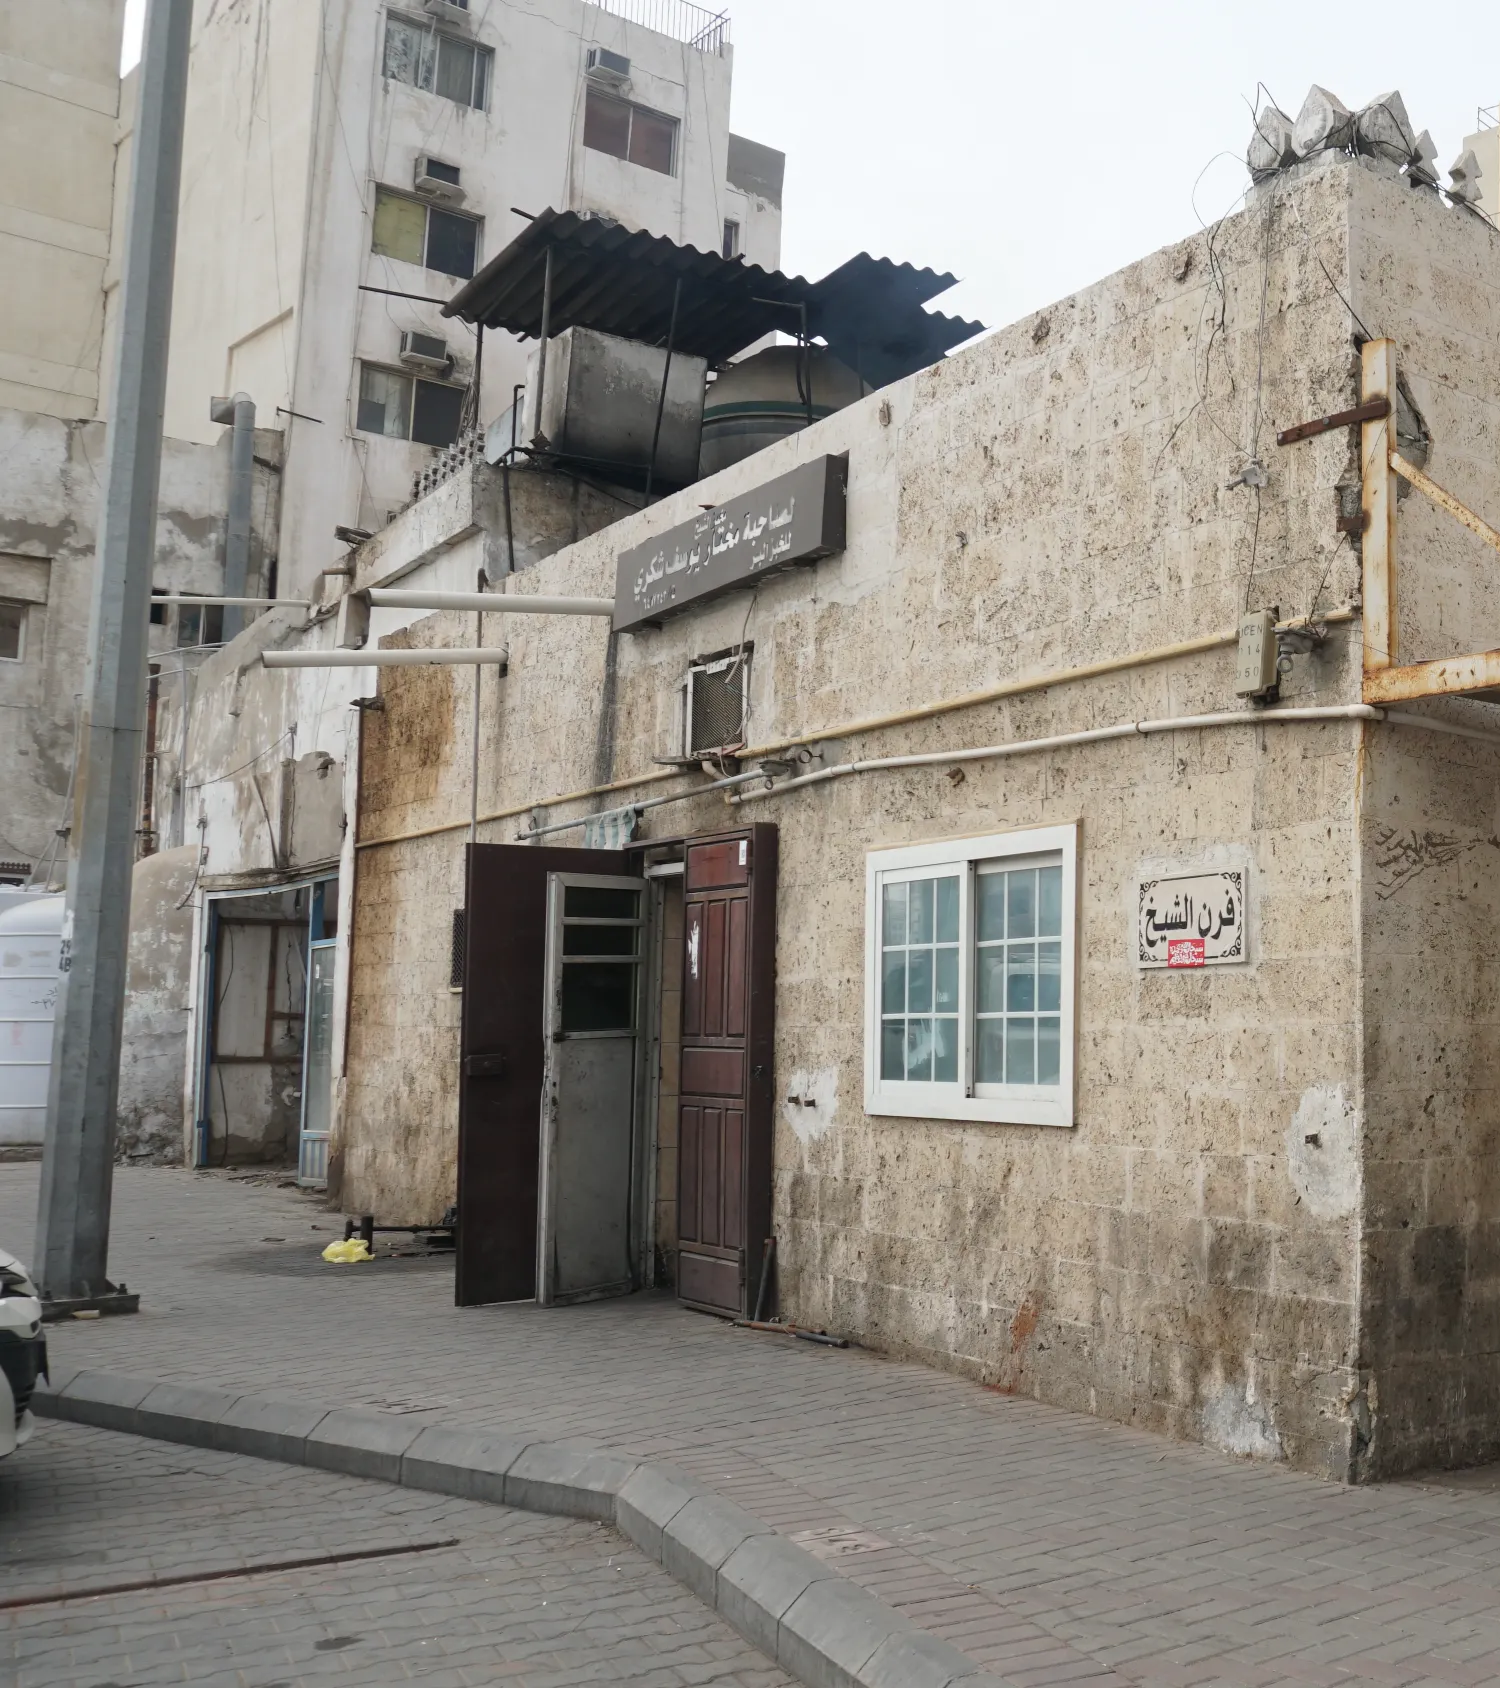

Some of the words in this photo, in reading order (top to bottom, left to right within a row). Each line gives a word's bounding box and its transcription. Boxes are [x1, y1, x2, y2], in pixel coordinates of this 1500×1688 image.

[633, 550, 665, 602] شكري
[665, 542, 701, 574] يوسف
[1145, 892, 1193, 948] الشيخ
[1198, 889, 1235, 940] فرن
